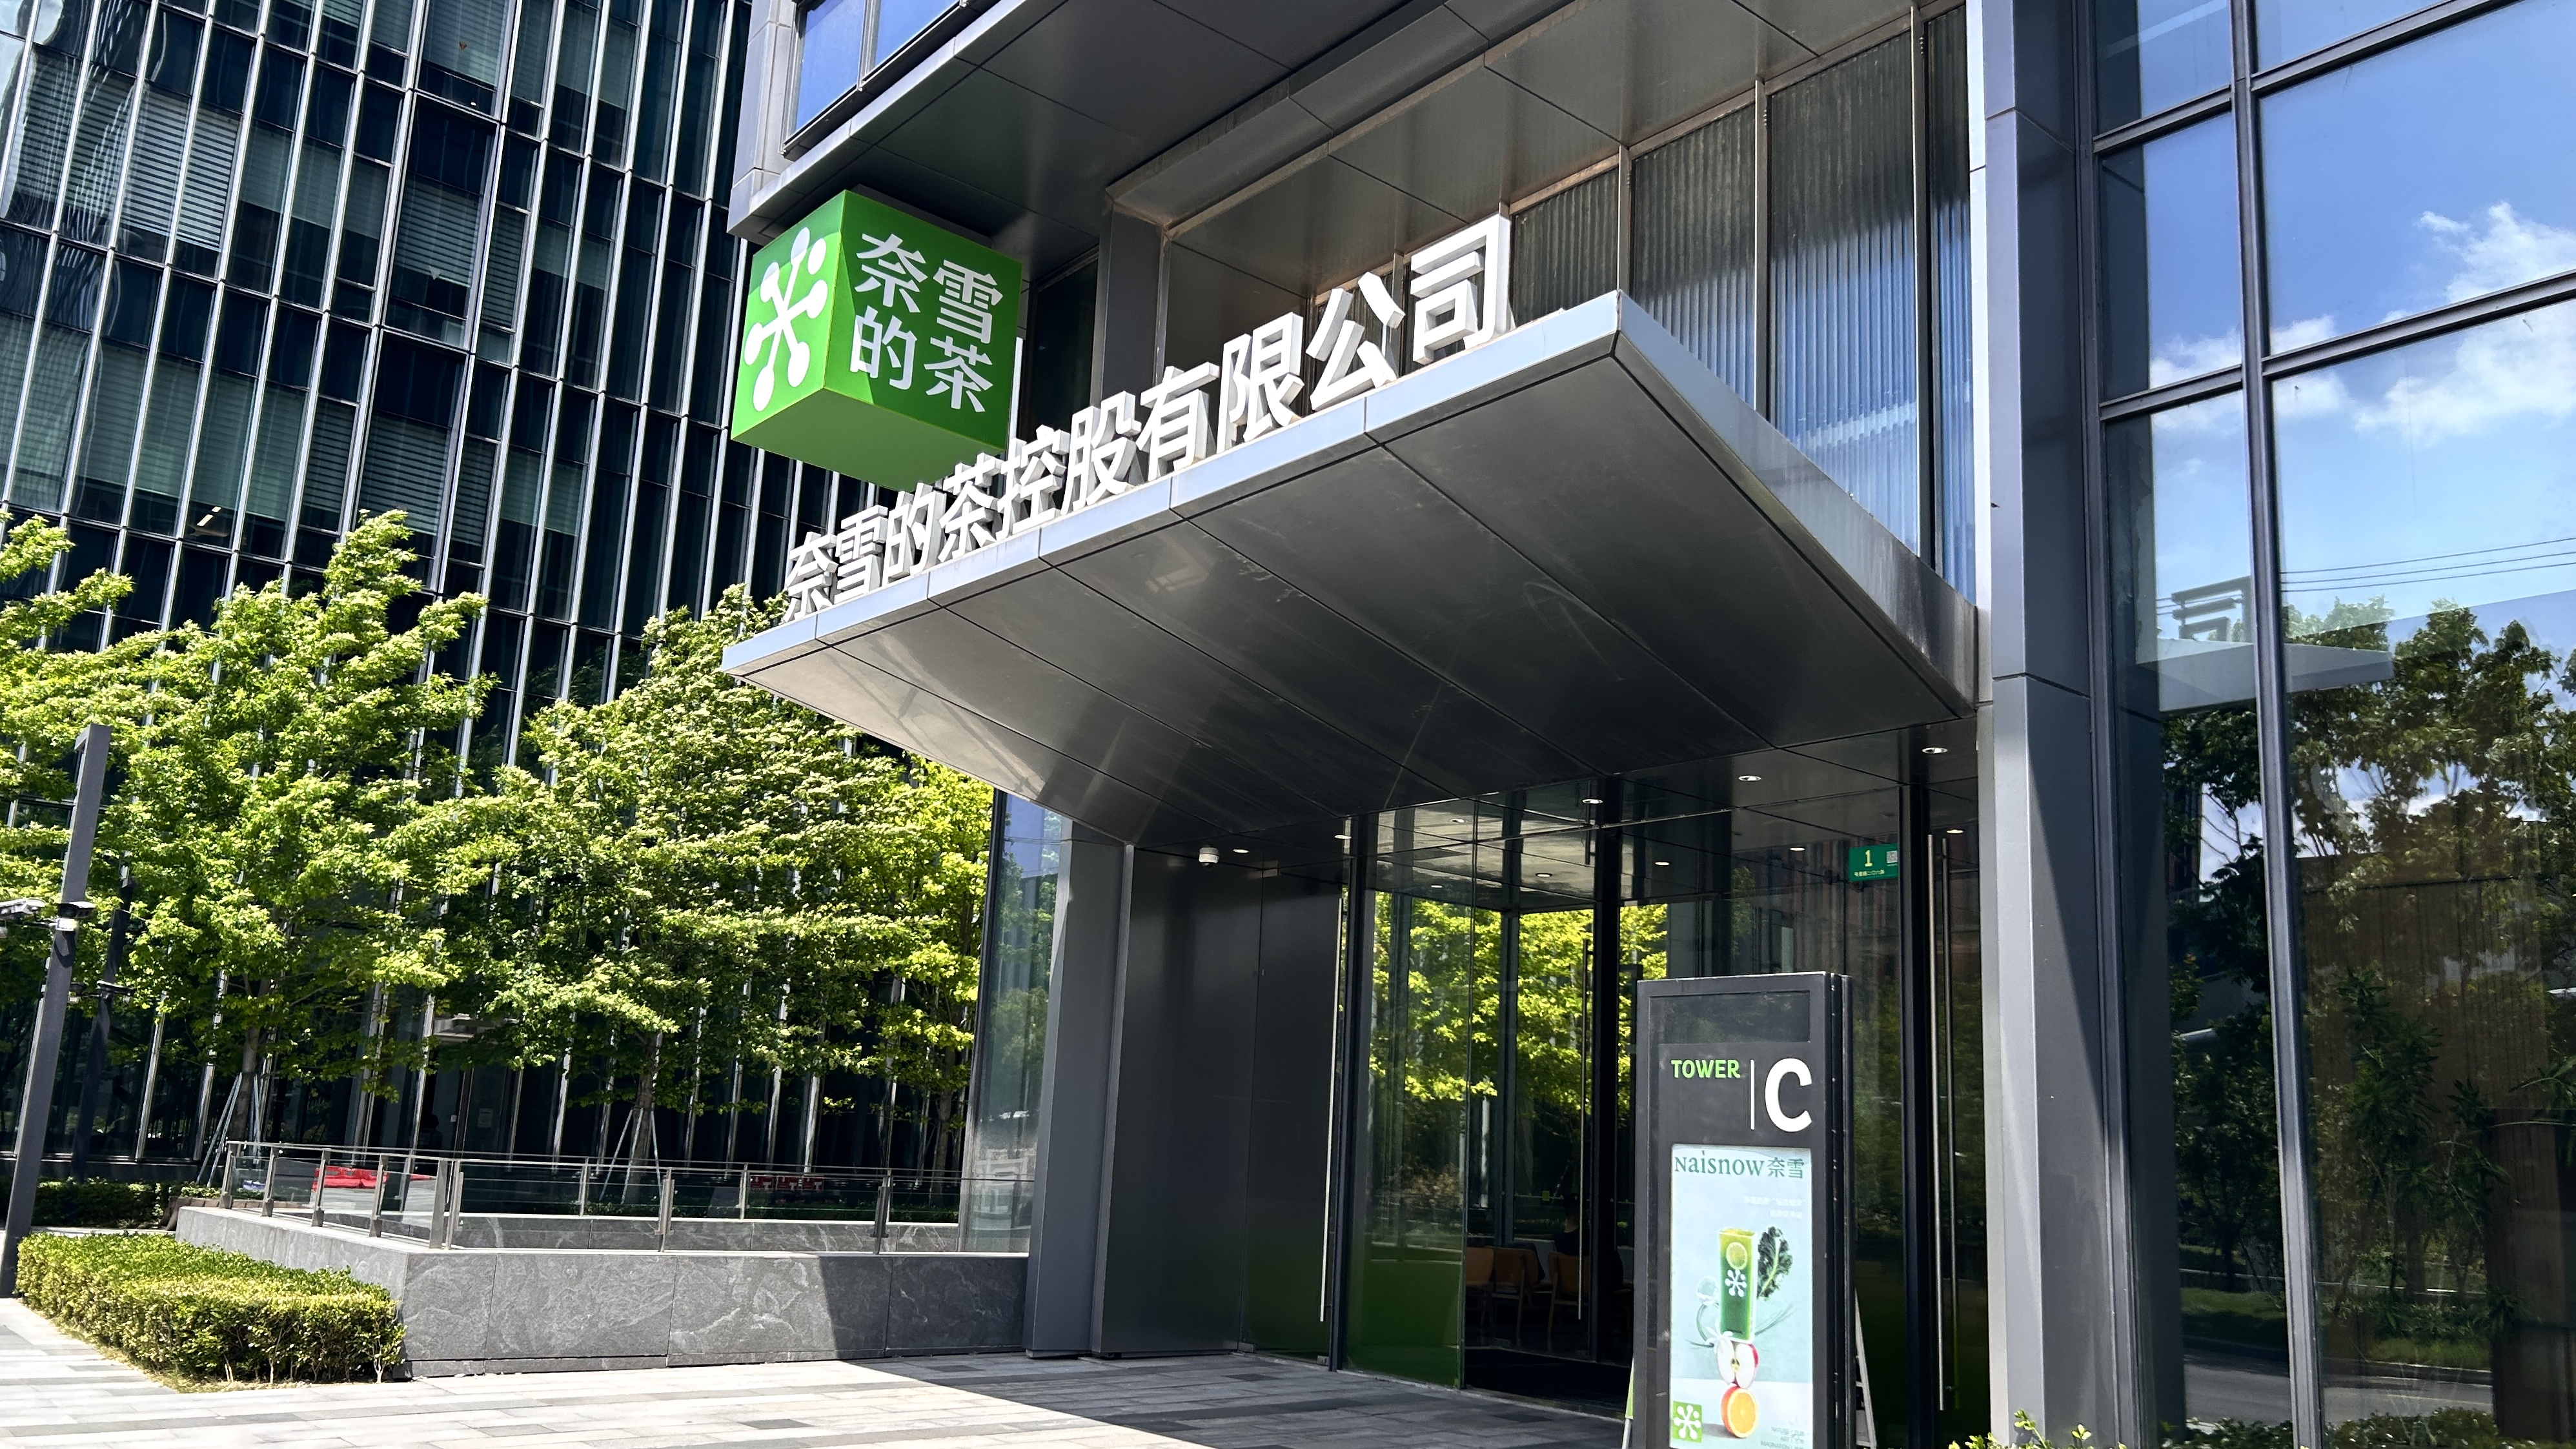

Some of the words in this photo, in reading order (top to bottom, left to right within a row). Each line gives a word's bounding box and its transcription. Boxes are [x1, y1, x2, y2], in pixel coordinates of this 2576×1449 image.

[855, 233, 1003, 343] 奈雪
[850, 305, 993, 412] 的茶
[783, 214, 1512, 623] 奈雪的茶控股有限公司
[1864, 849, 1873, 867] 1
[1670, 1059, 1741, 1079] TOWER
[1765, 1057, 1812, 1133] C
[1767, 1157, 1805, 1179] 奈雪
